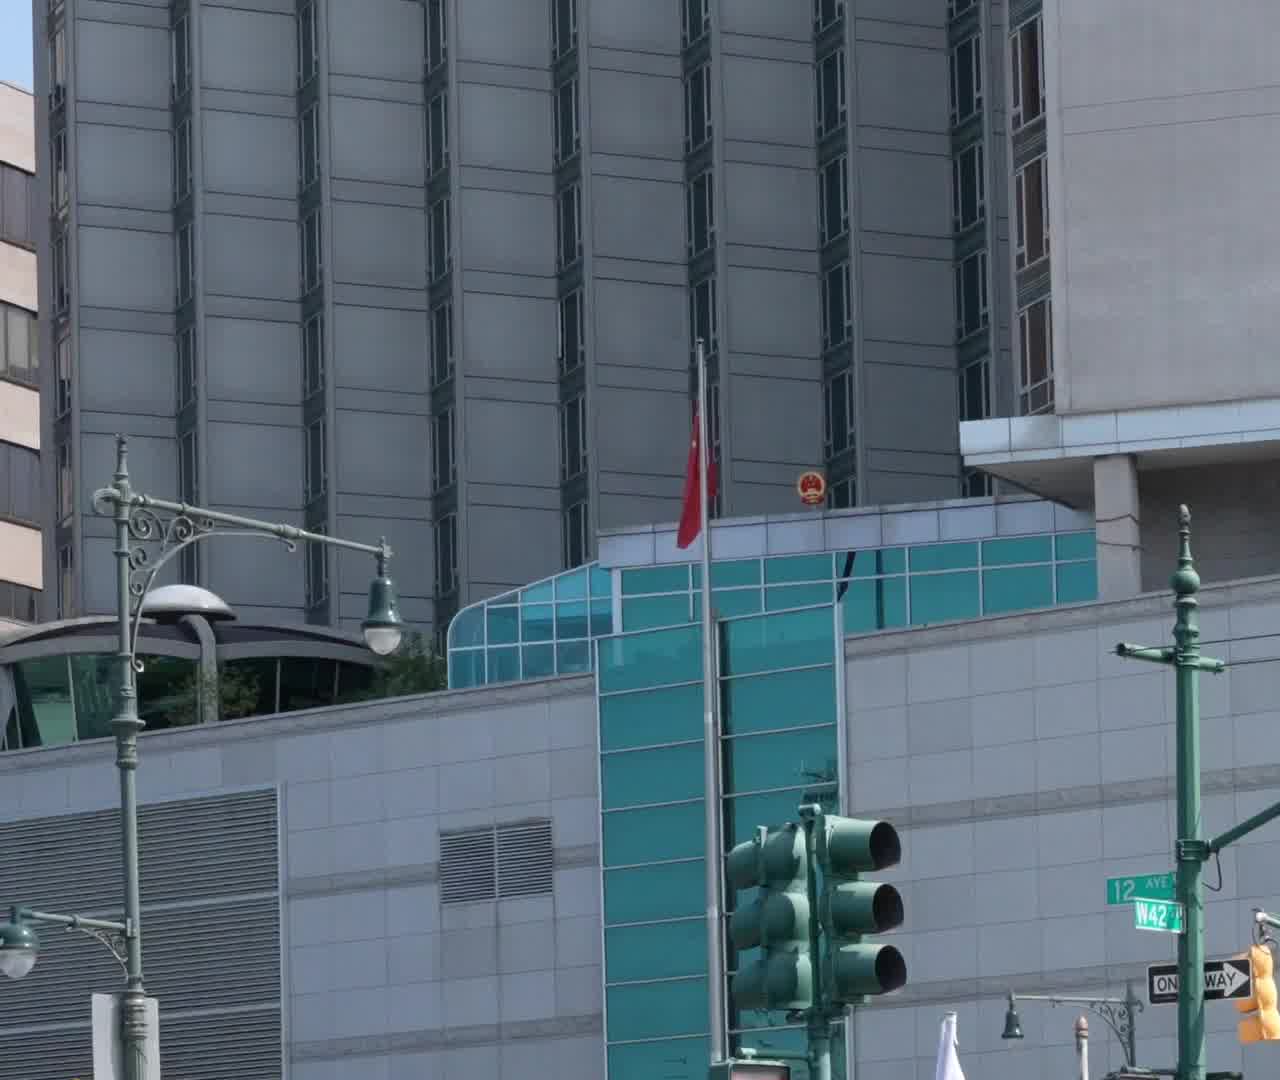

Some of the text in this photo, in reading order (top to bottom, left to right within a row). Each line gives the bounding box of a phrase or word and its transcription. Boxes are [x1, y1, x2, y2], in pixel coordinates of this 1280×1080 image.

[1114, 880, 1136, 900] 12
[1156, 972, 1237, 992] ON WAY
